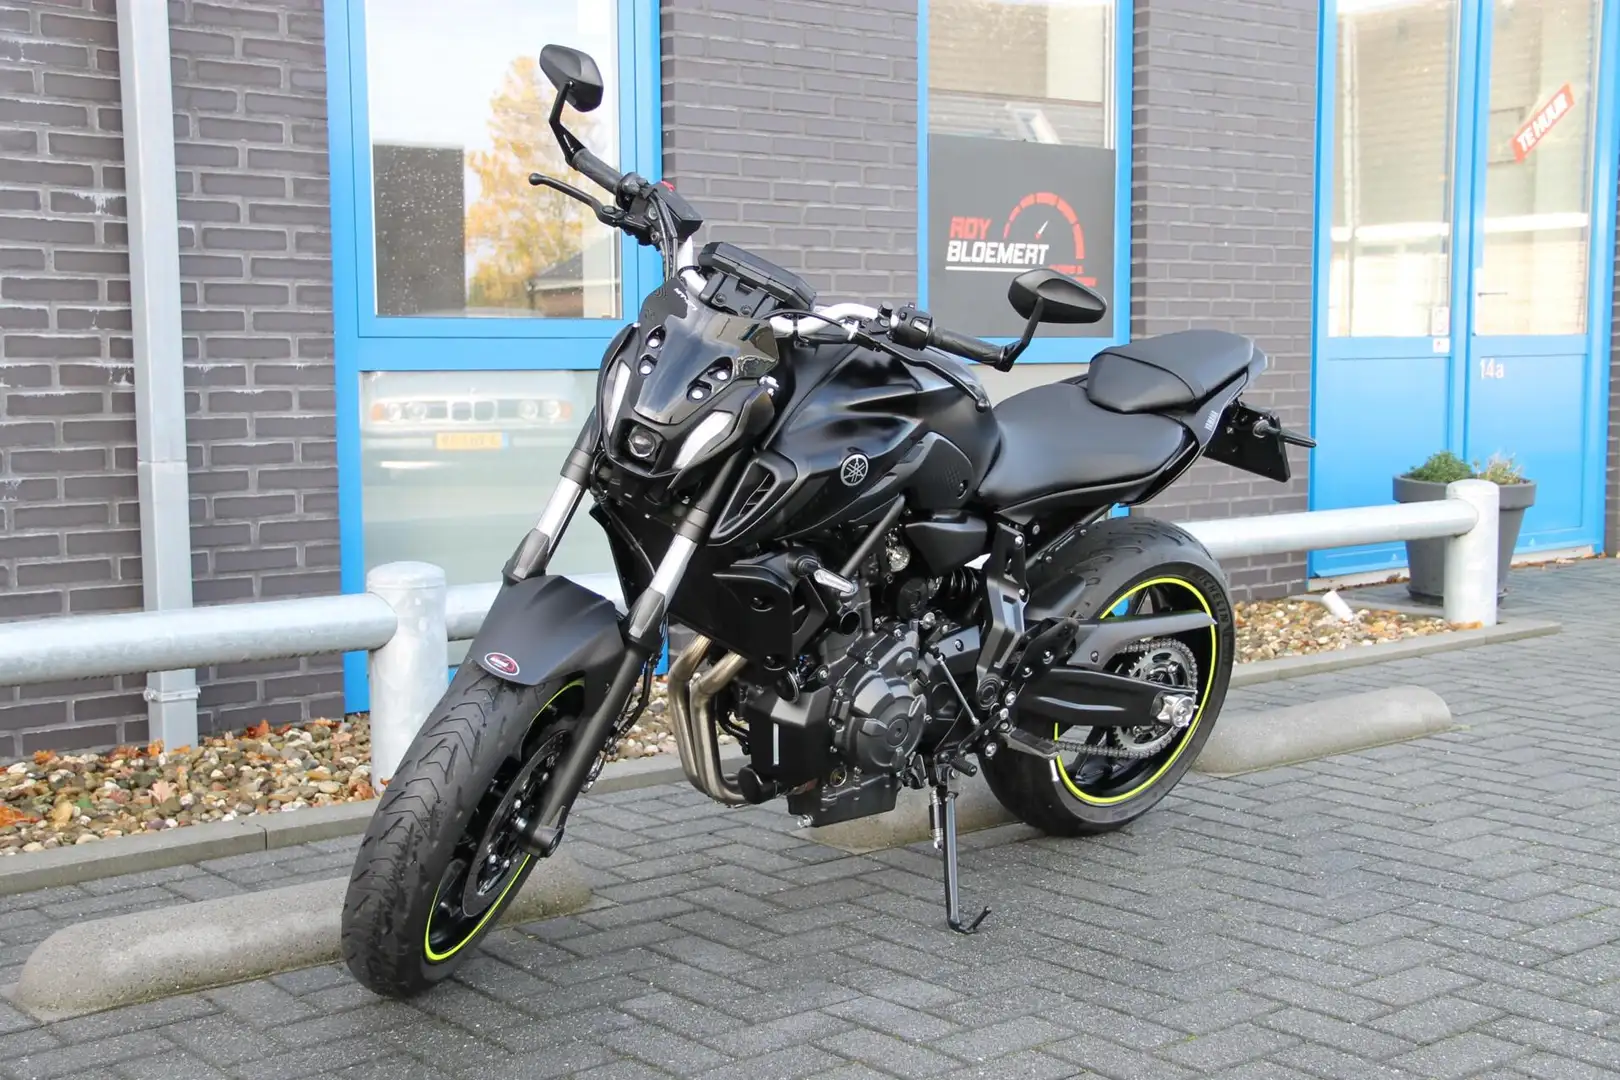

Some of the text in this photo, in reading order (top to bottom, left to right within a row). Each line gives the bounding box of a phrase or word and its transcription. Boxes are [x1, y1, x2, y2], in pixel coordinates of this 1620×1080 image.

[949, 216, 992, 240] ROY
[946, 240, 1050, 265] BLOEMERT
[1480, 358, 1504, 380] 14a
[1195, 570, 1230, 623] ICHELIN
